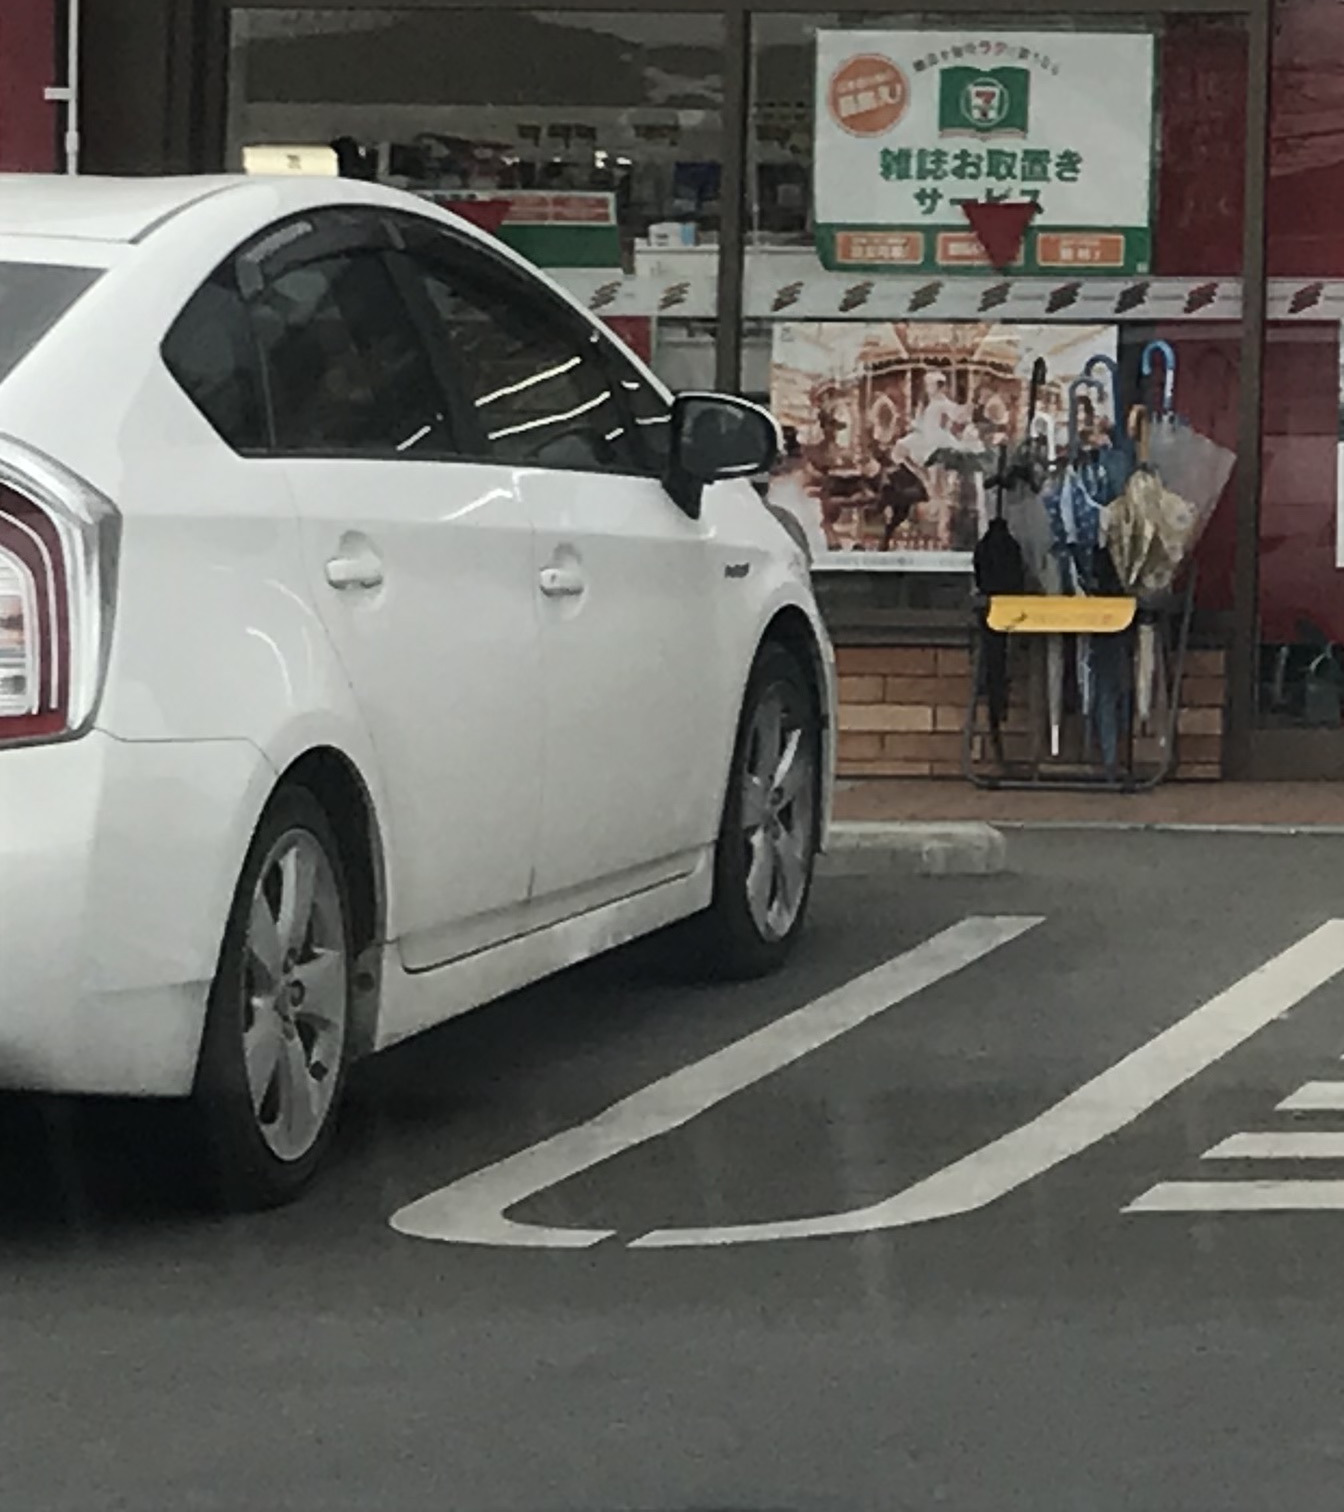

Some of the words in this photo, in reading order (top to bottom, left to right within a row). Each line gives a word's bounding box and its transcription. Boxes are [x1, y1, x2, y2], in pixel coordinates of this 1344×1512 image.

[880, 147, 1083, 183] 雑誌お取置き
